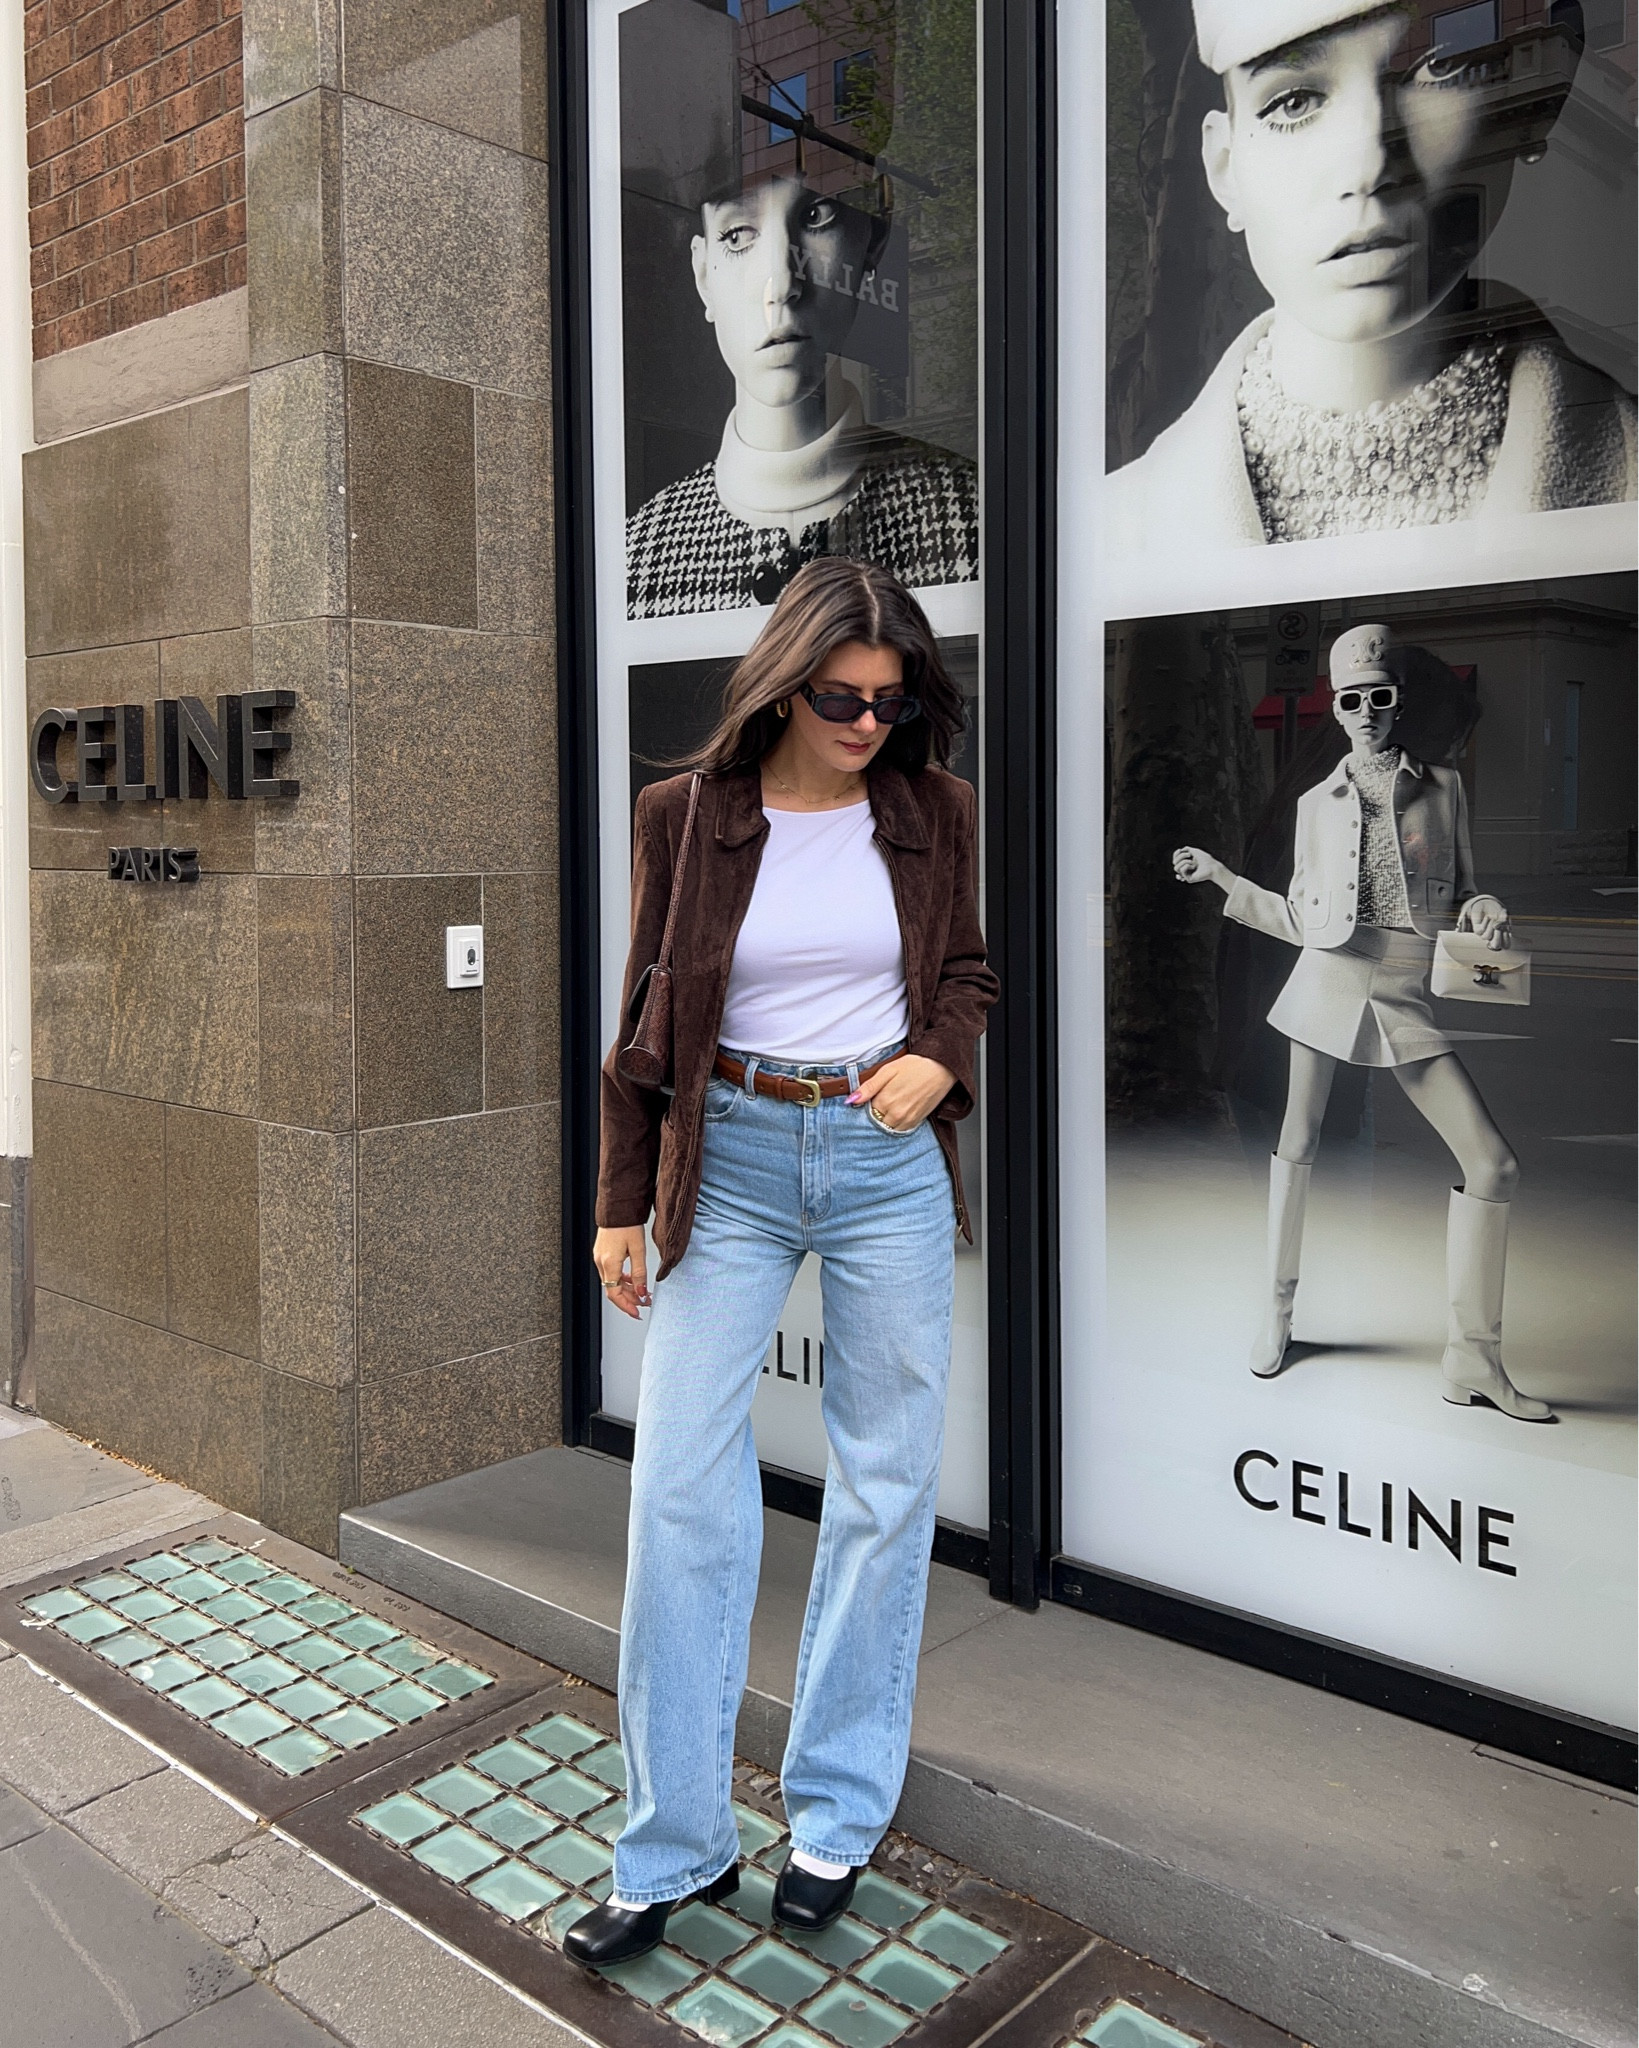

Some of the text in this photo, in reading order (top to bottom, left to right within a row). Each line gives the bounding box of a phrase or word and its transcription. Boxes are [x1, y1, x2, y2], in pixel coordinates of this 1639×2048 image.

[30, 689, 299, 803] CELINE
[108, 846, 200, 882] PARIS
[1233, 1449, 1517, 1577] CELINE
